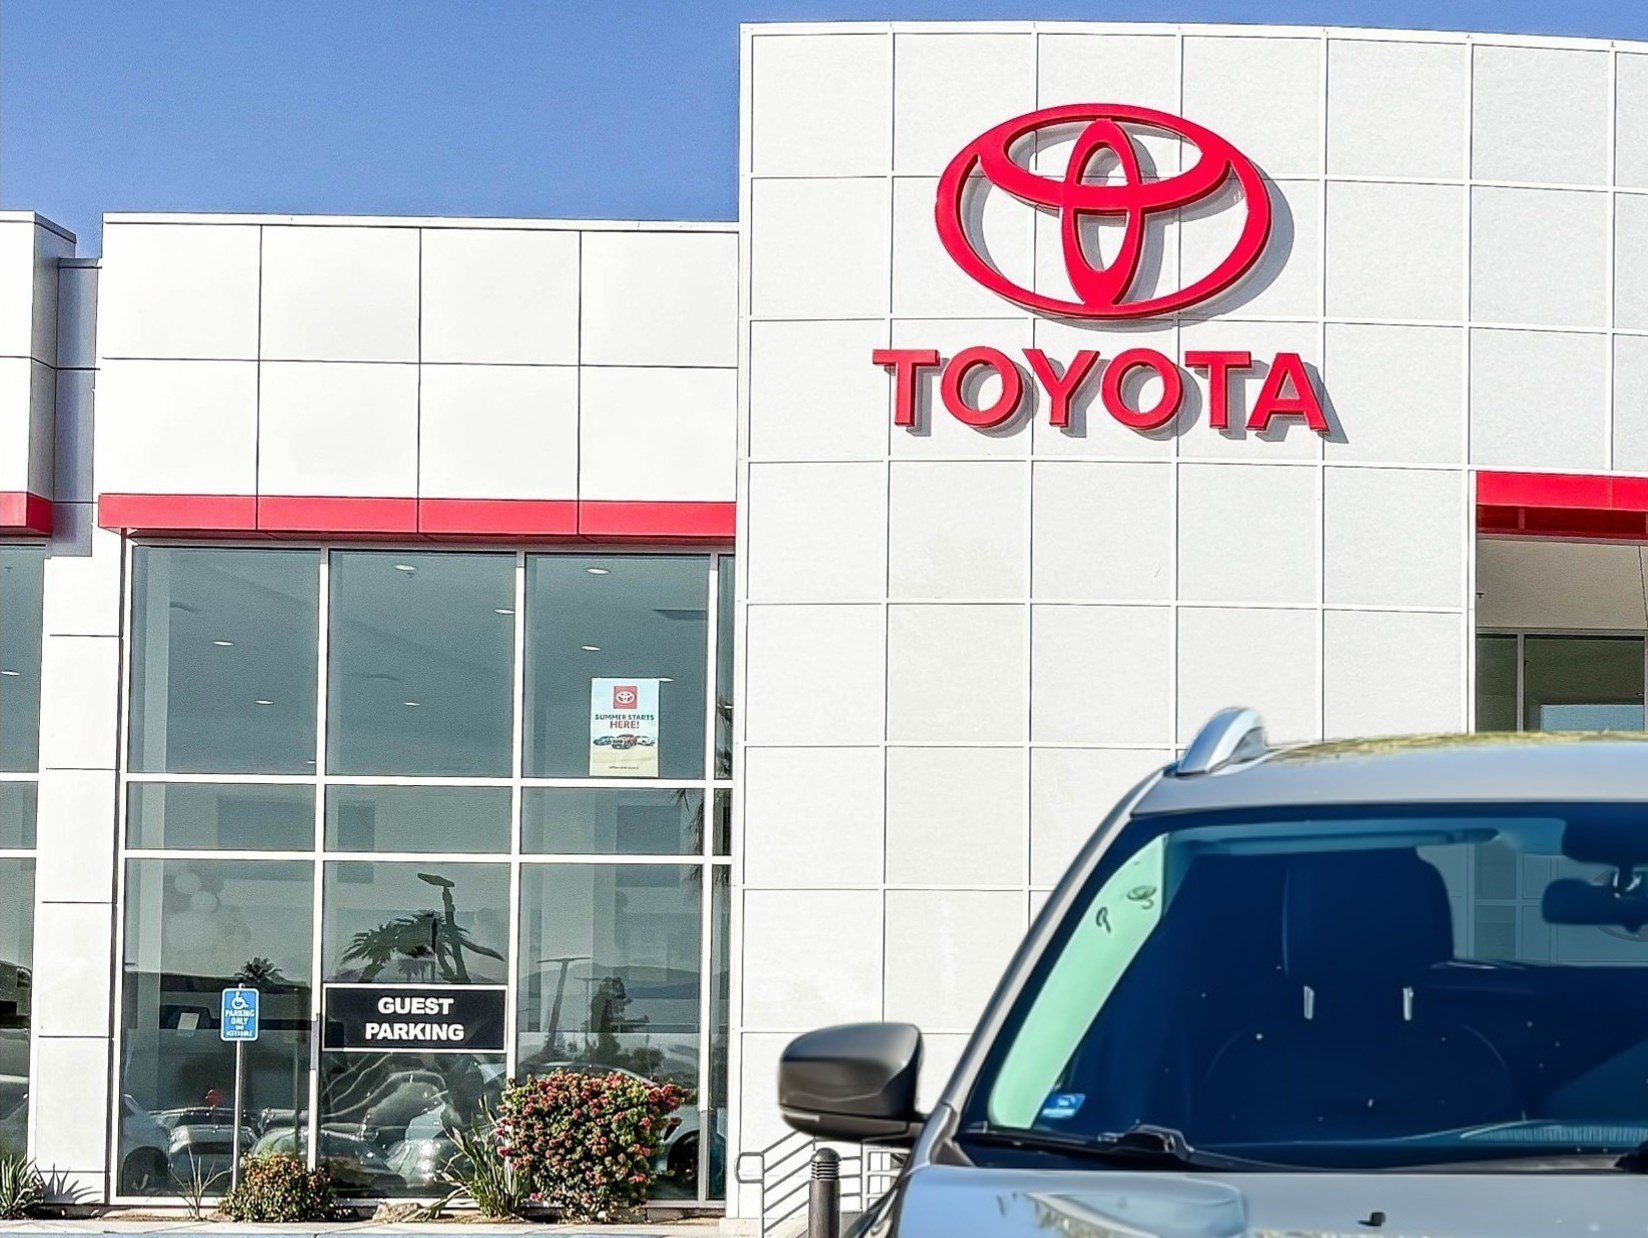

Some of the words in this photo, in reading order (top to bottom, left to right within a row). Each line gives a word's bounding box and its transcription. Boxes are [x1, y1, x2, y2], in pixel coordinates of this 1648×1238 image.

[872, 346, 1330, 435] TOYOTA
[609, 720, 640, 729] HERE!
[377, 997, 454, 1015] GUEST
[225, 1009, 255, 1017] PARKING
[230, 1017, 248, 1025] ONLY
[365, 1022, 465, 1041] PARKING
